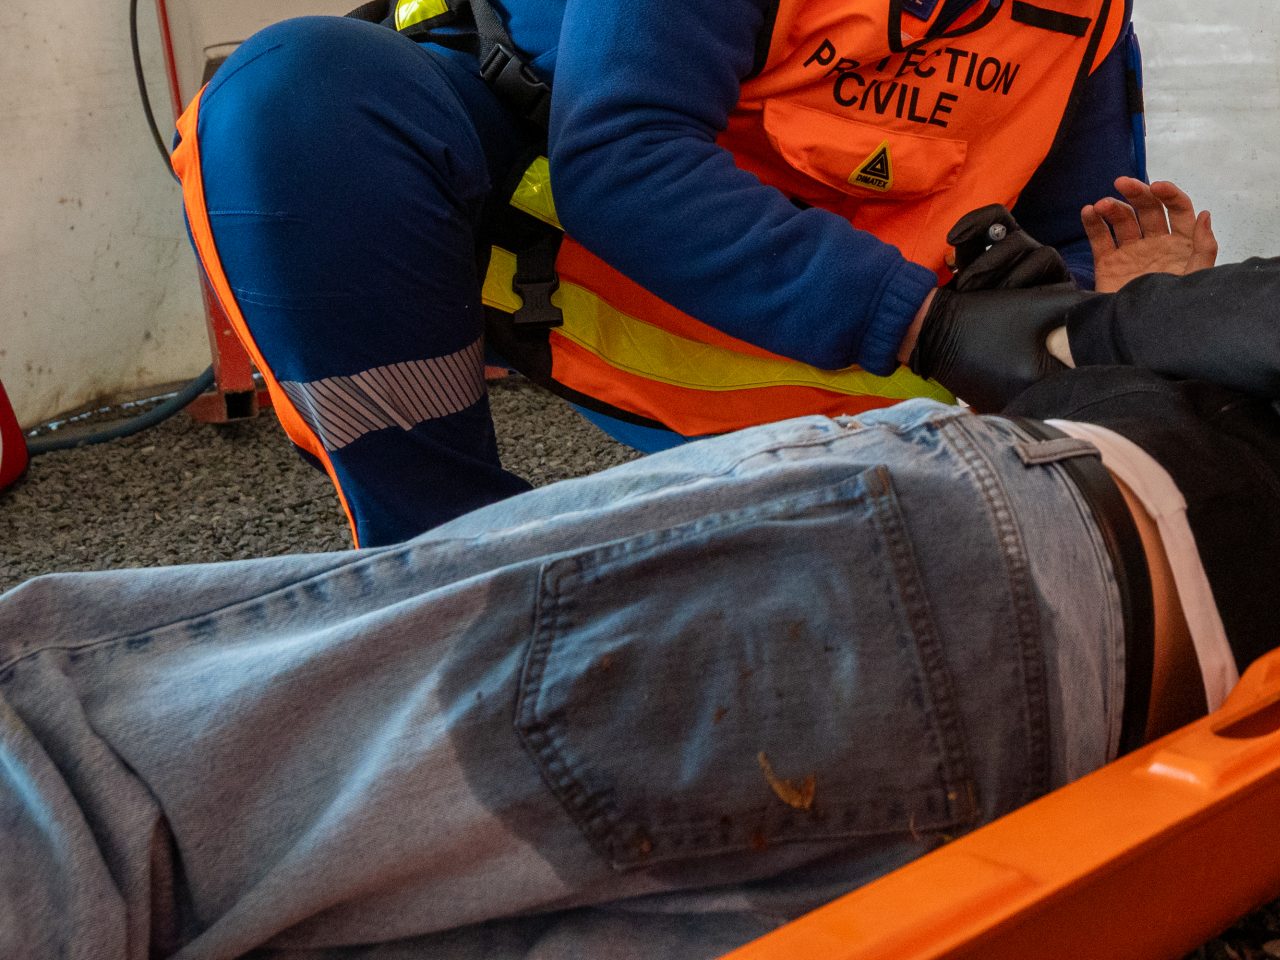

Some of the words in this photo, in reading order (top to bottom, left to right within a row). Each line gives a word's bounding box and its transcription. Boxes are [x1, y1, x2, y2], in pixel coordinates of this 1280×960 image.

[802, 38, 1020, 96] PRECTION
[833, 71, 959, 128] CIVILE
[855, 174, 889, 189] DIMATEX
